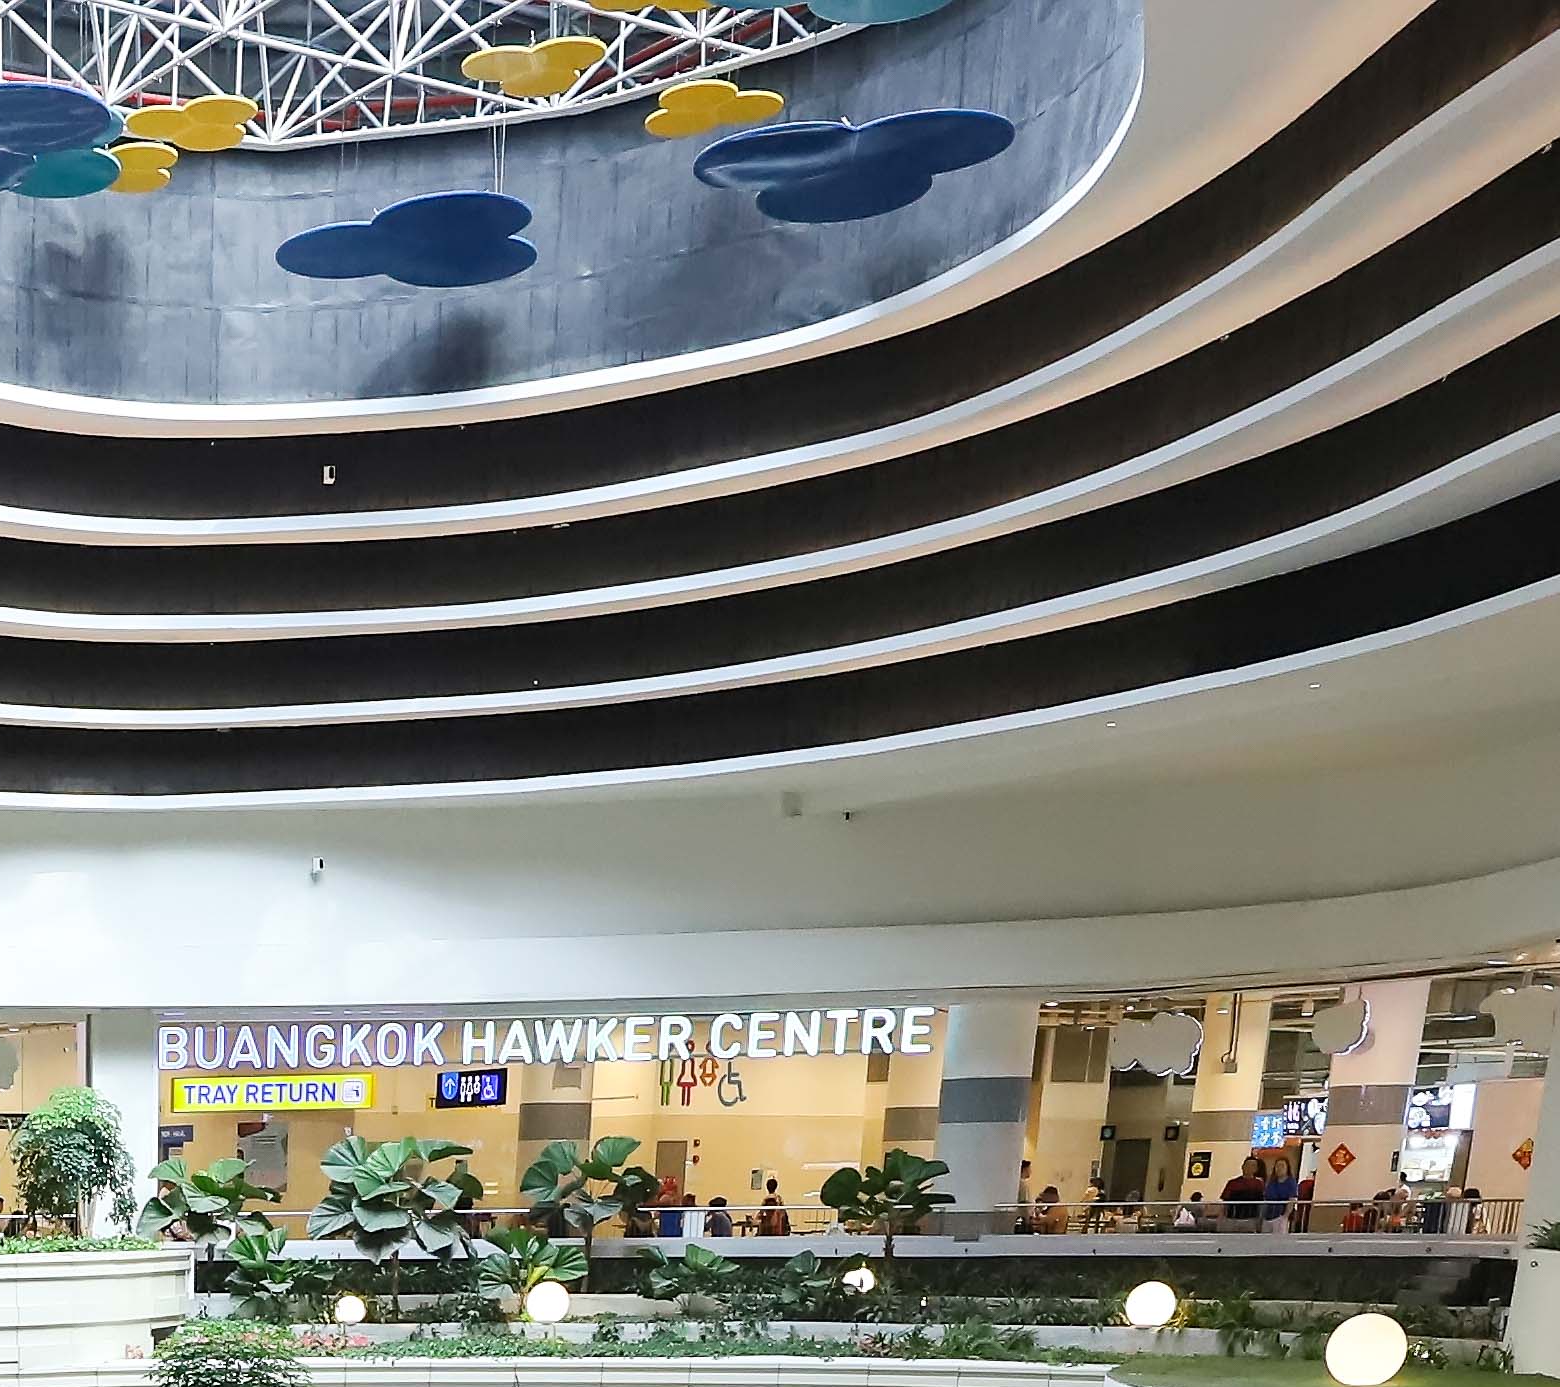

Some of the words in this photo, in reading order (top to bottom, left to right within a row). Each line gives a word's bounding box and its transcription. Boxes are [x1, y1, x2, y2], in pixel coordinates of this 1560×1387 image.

[158, 1020, 446, 1071] BUANGKOK
[460, 1014, 693, 1066] HAWKER
[710, 1005, 937, 1059] CENTRE
[184, 1084, 238, 1104] TRAY
[246, 1082, 336, 1103] RETURN
